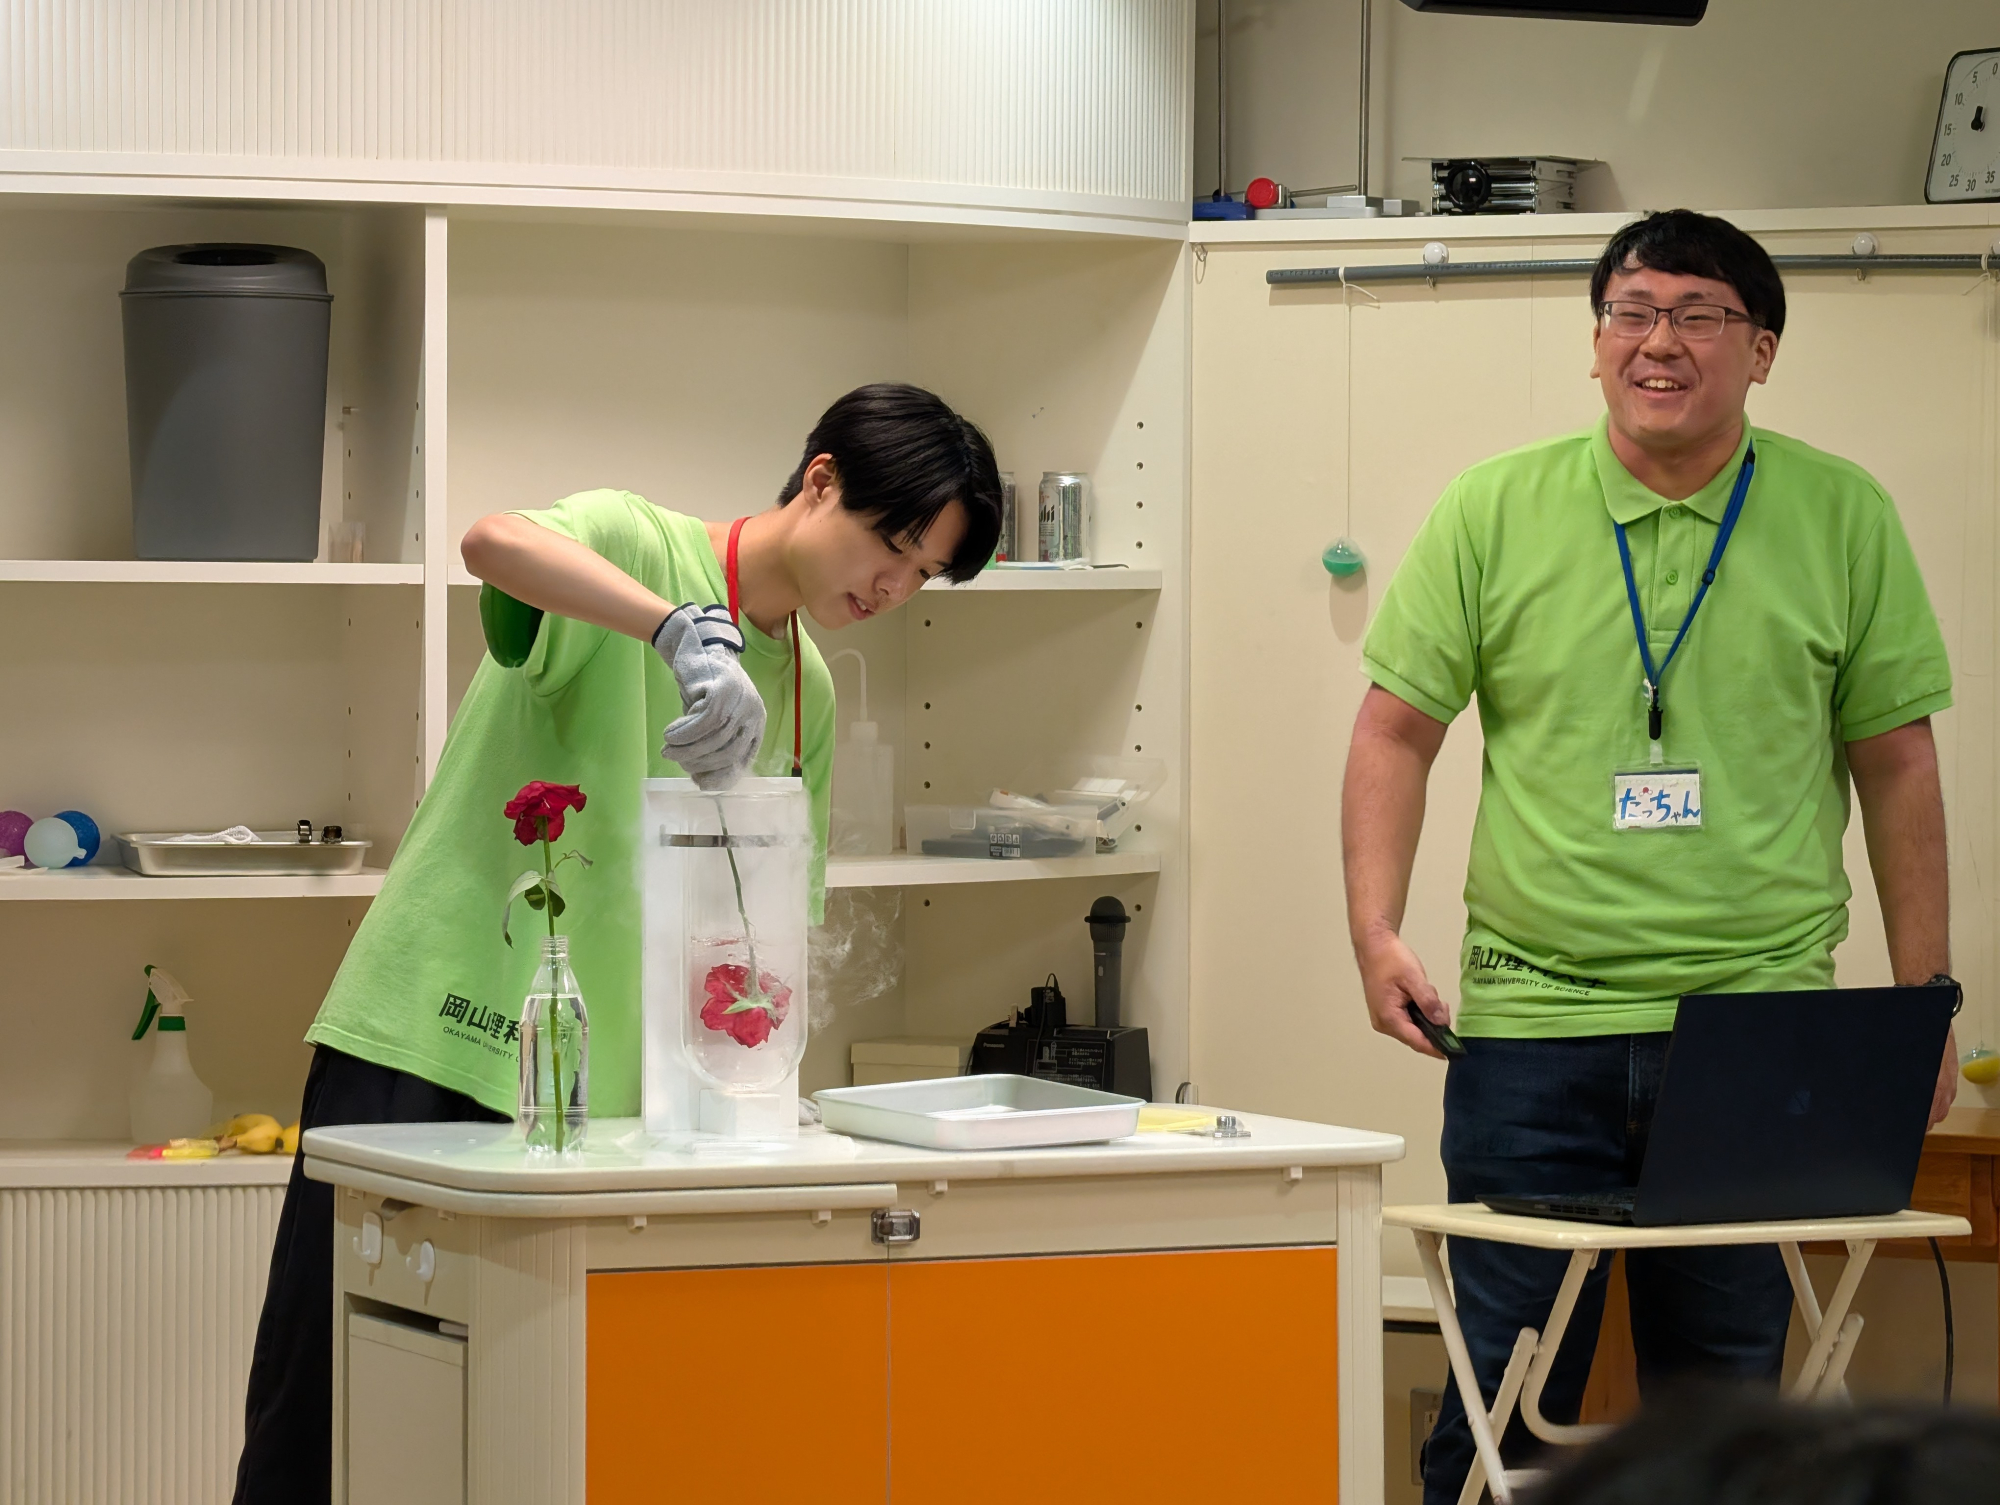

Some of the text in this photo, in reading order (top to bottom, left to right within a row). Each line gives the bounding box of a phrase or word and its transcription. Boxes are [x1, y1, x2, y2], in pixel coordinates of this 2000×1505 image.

[1992, 62, 1999, 76] 0
[1971, 71, 1979, 84] 5
[1954, 92, 1964, 106] 10
[1943, 123, 1953, 136] 15
[1940, 153, 1952, 167] 20
[1948, 174, 1960, 188] 25
[1984, 171, 1996, 184] 35
[1965, 179, 1977, 192] 30
[1618, 787, 1701, 824] たっちゃん
[1472, 976, 1591, 996] KAYAMA UNIVERSITY OF SCIENCE
[443, 1026, 481, 1046] OKAYAMA
